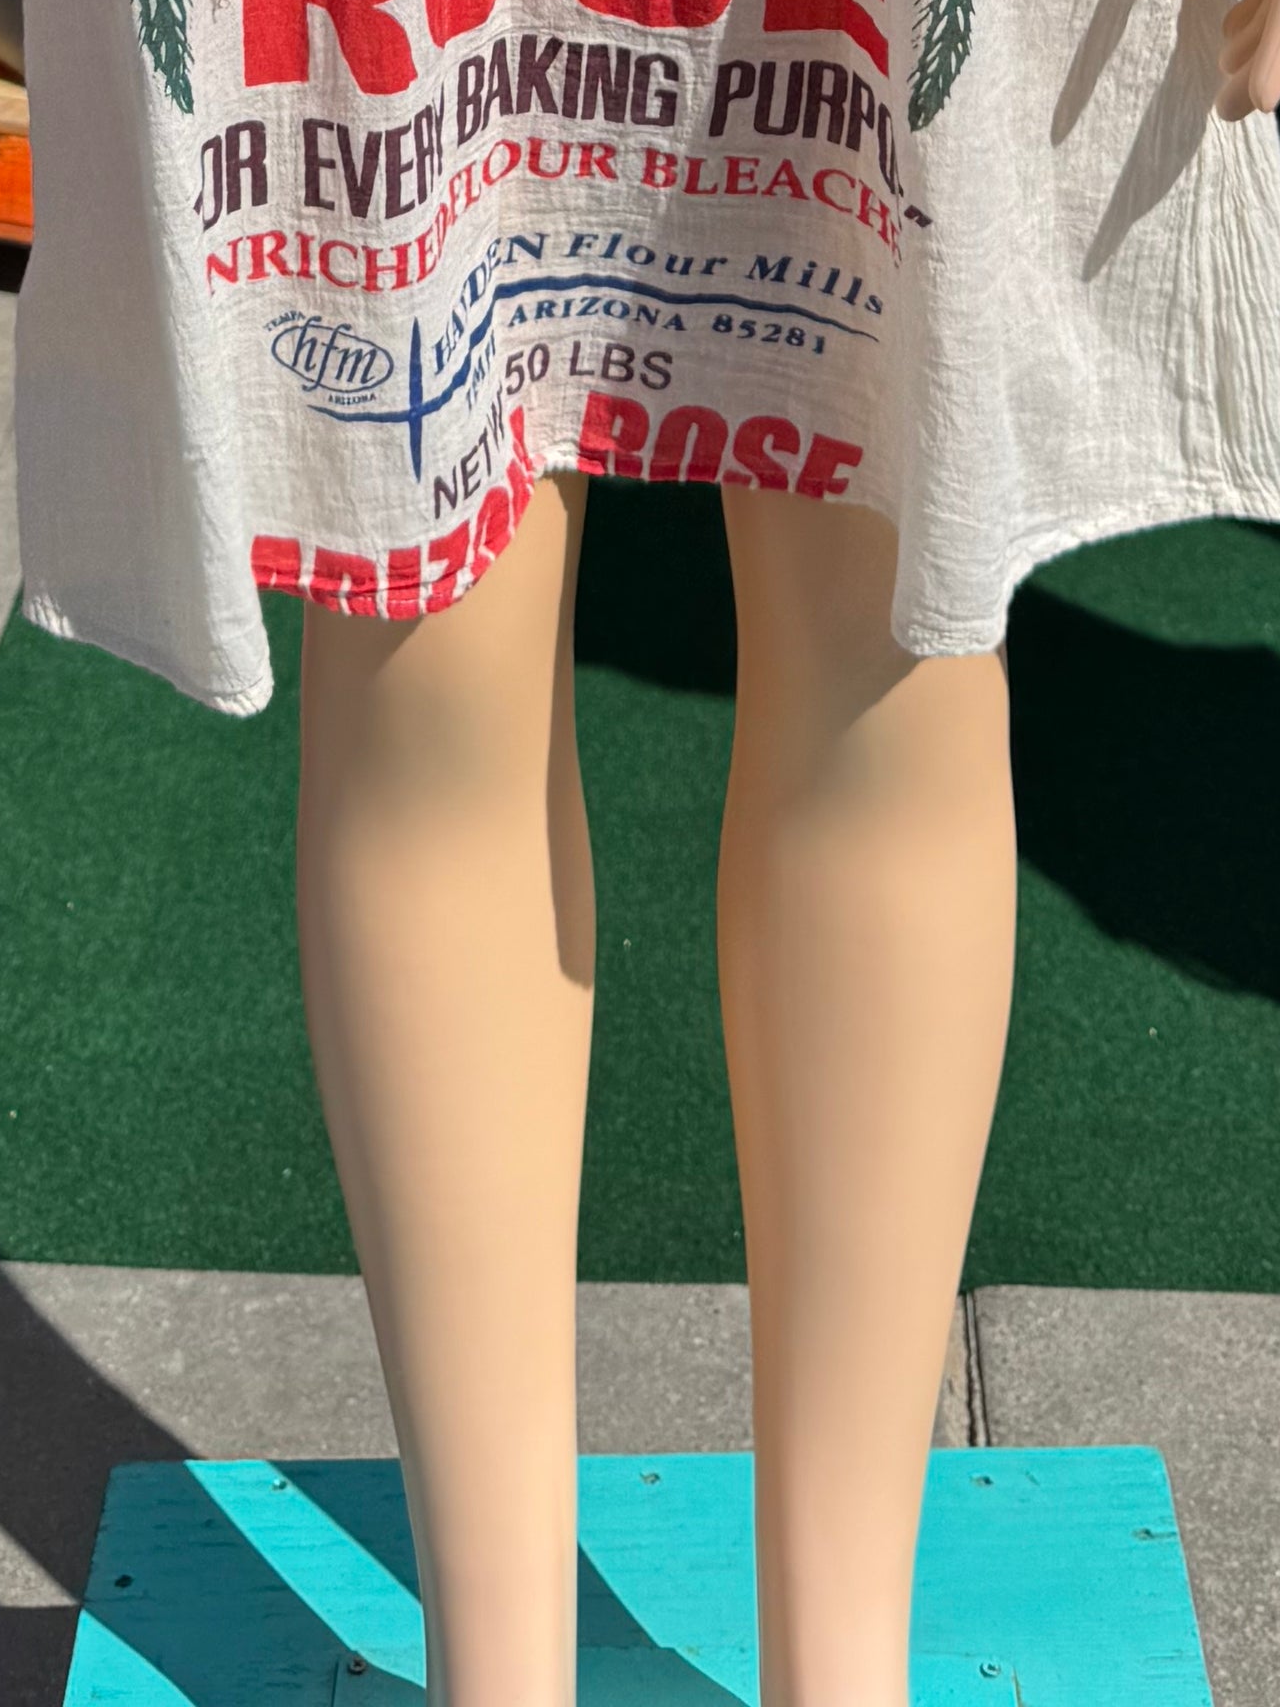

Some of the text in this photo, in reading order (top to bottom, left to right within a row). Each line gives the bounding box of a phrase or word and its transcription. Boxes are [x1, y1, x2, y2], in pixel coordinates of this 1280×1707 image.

[193, 32, 932, 232] OR EVERY BAKING PURPO
[565, 232, 728, 277] Flour
[745, 253, 884, 316] Mills
[507, 296, 688, 333] ARIZONA
[710, 312, 827, 355] 85281
[504, 342, 551, 396] 50
[568, 339, 675, 391] LBS
